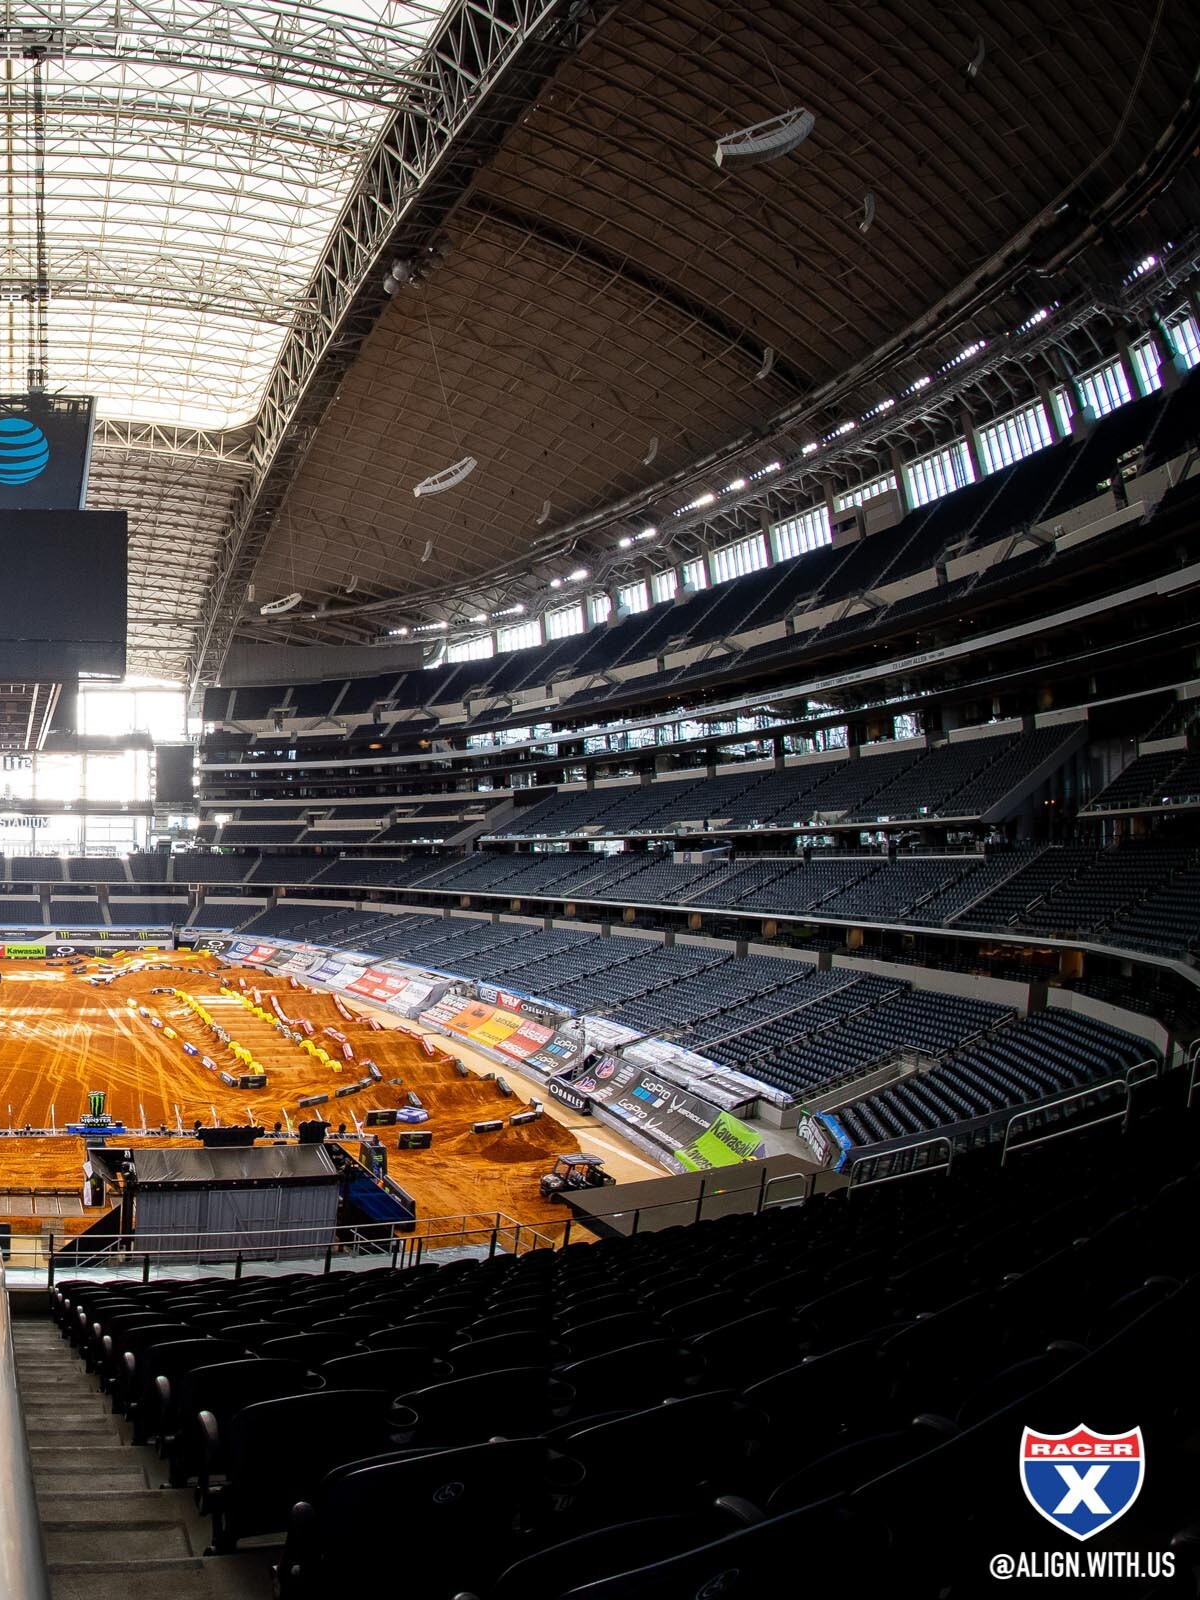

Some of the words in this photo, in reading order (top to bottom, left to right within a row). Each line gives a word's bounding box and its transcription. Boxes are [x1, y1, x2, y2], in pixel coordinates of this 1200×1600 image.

[0, 816, 50, 828] STADIUM
[7, 947, 44, 955] Kawasaki
[517, 1026, 549, 1045] GASGAS
[554, 1037, 578, 1053] GoPro
[534, 1053, 559, 1068] GoPro
[640, 1077, 671, 1099] GoPro
[617, 1098, 648, 1119] GoPro
[710, 1119, 752, 1157] Kawasaki
